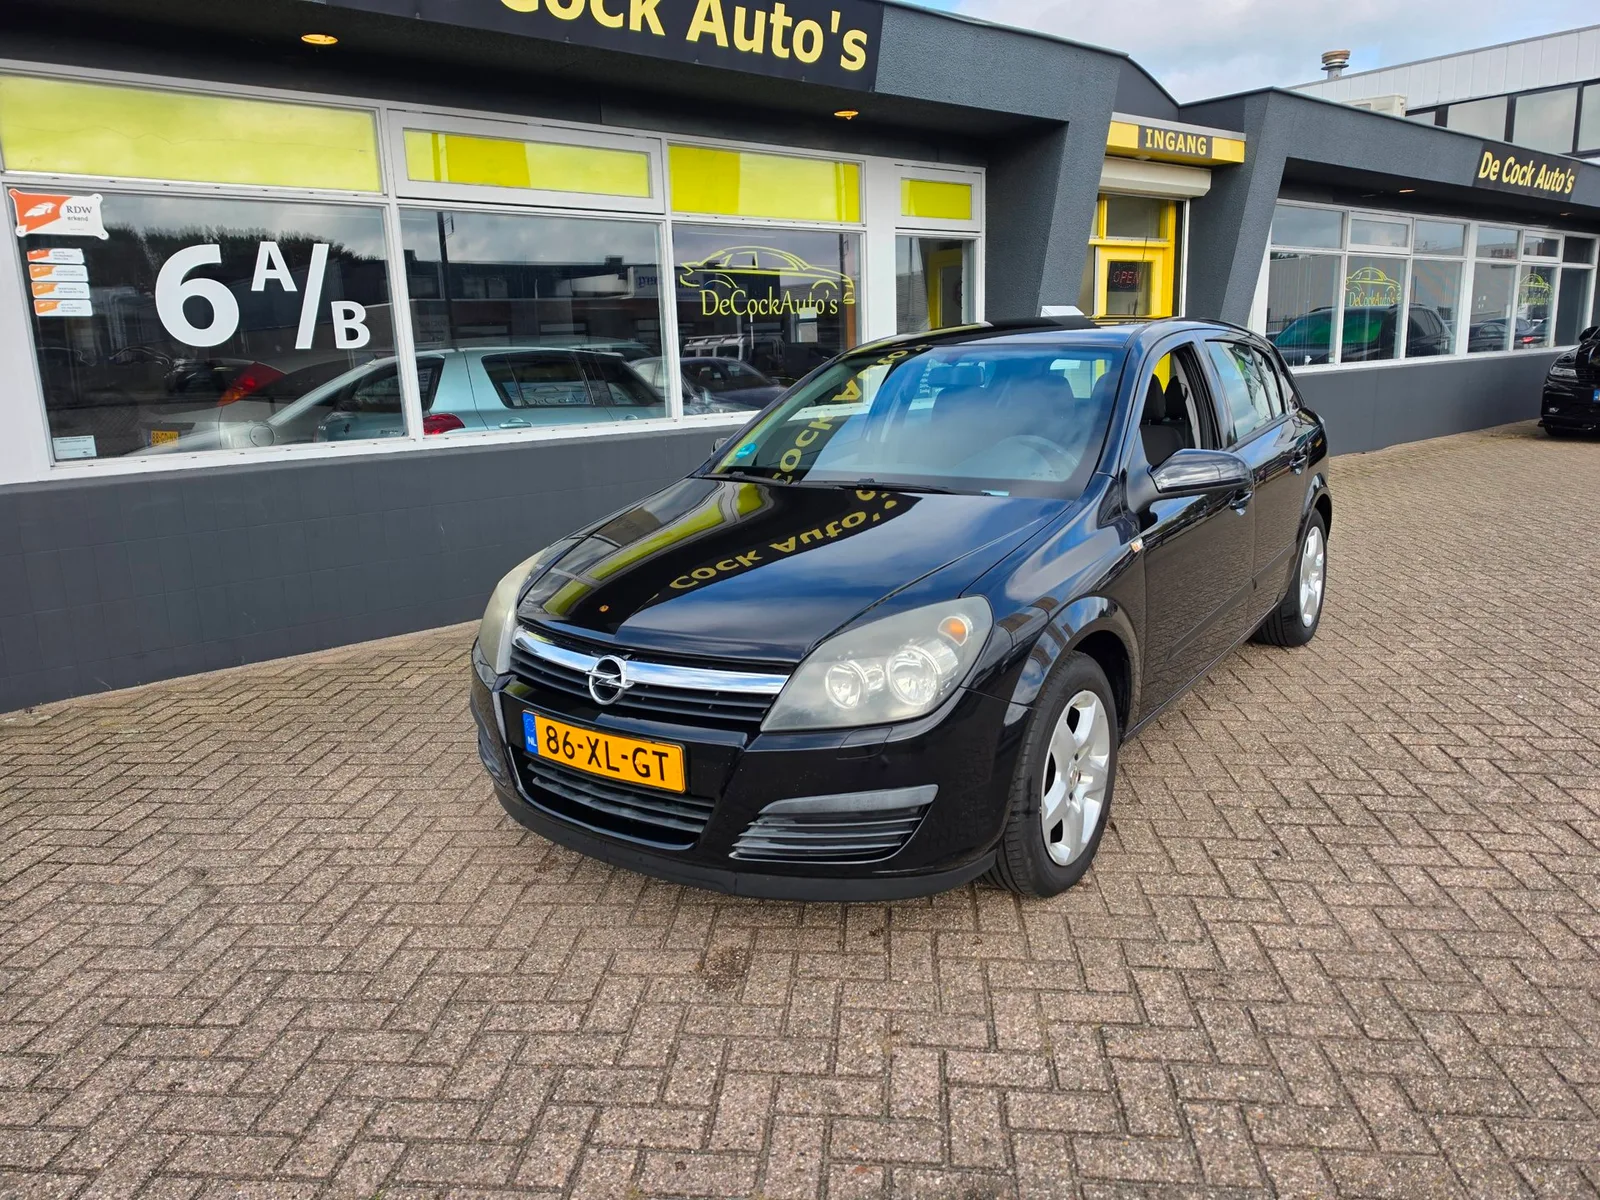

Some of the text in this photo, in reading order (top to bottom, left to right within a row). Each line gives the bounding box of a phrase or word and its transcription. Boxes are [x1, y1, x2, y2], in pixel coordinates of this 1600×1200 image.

[503, 0, 868, 71] ock Auto's
[1145, 128, 1207, 156] INGANG
[1478, 151, 1575, 194] De Cock Auto's
[65, 205, 93, 215] RDW
[1112, 269, 1142, 285] OPEN
[700, 286, 839, 316] DeCockAuto's
[527, 735, 538, 748] NL
[545, 724, 669, 782] 86-XL-GT
